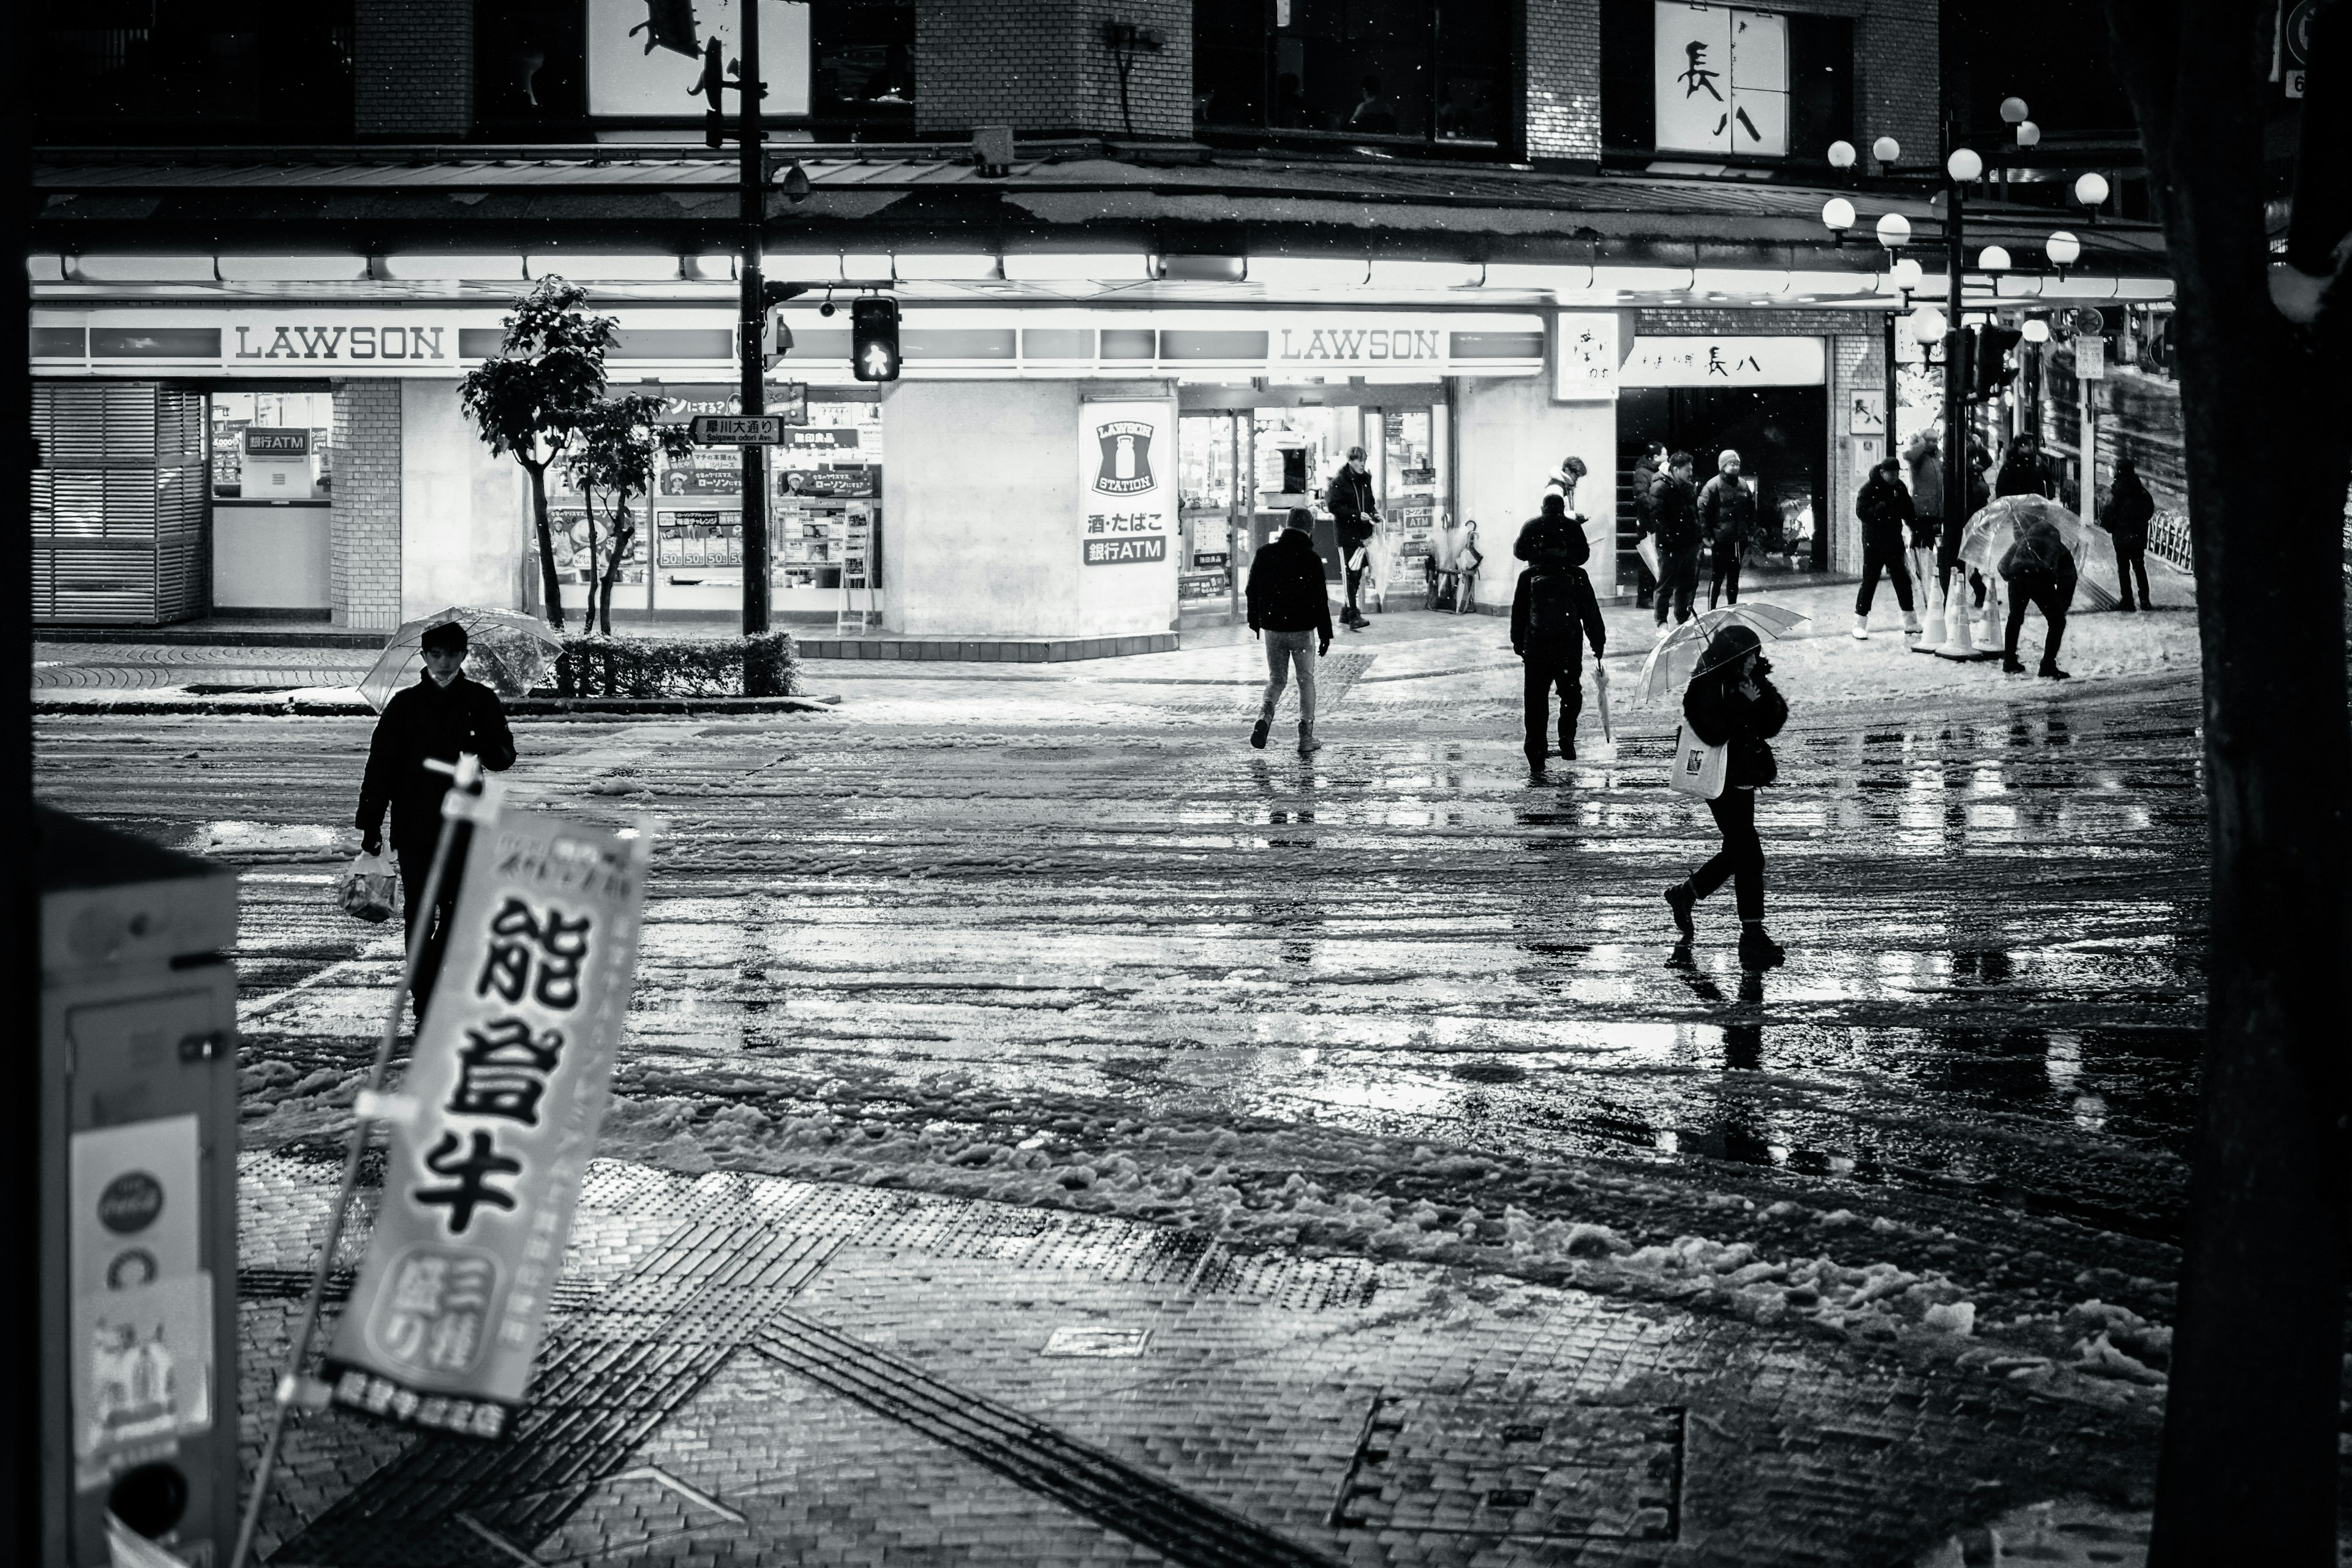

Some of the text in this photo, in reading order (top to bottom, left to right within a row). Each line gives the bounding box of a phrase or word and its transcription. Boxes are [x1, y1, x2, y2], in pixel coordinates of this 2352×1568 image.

[1677, 40, 1762, 143] 長八
[236, 326, 445, 359] LAWSON
[1281, 329, 1439, 360] LAWSON
[1705, 345, 1761, 377] 長八
[706, 420, 772, 434] 犀川大通り
[1097, 422, 1153, 439] LAWSON
[249, 435, 303, 448] 銀行ATM
[707, 434, 736, 442] Saigawa
[1099, 475, 1152, 491] STATION
[1087, 513, 1163, 533] 酒・たばこ
[1410, 517, 1428, 527] ATM
[1089, 540, 1161, 561] 銀行ATM
[413, 895, 591, 1235] 能登牛
